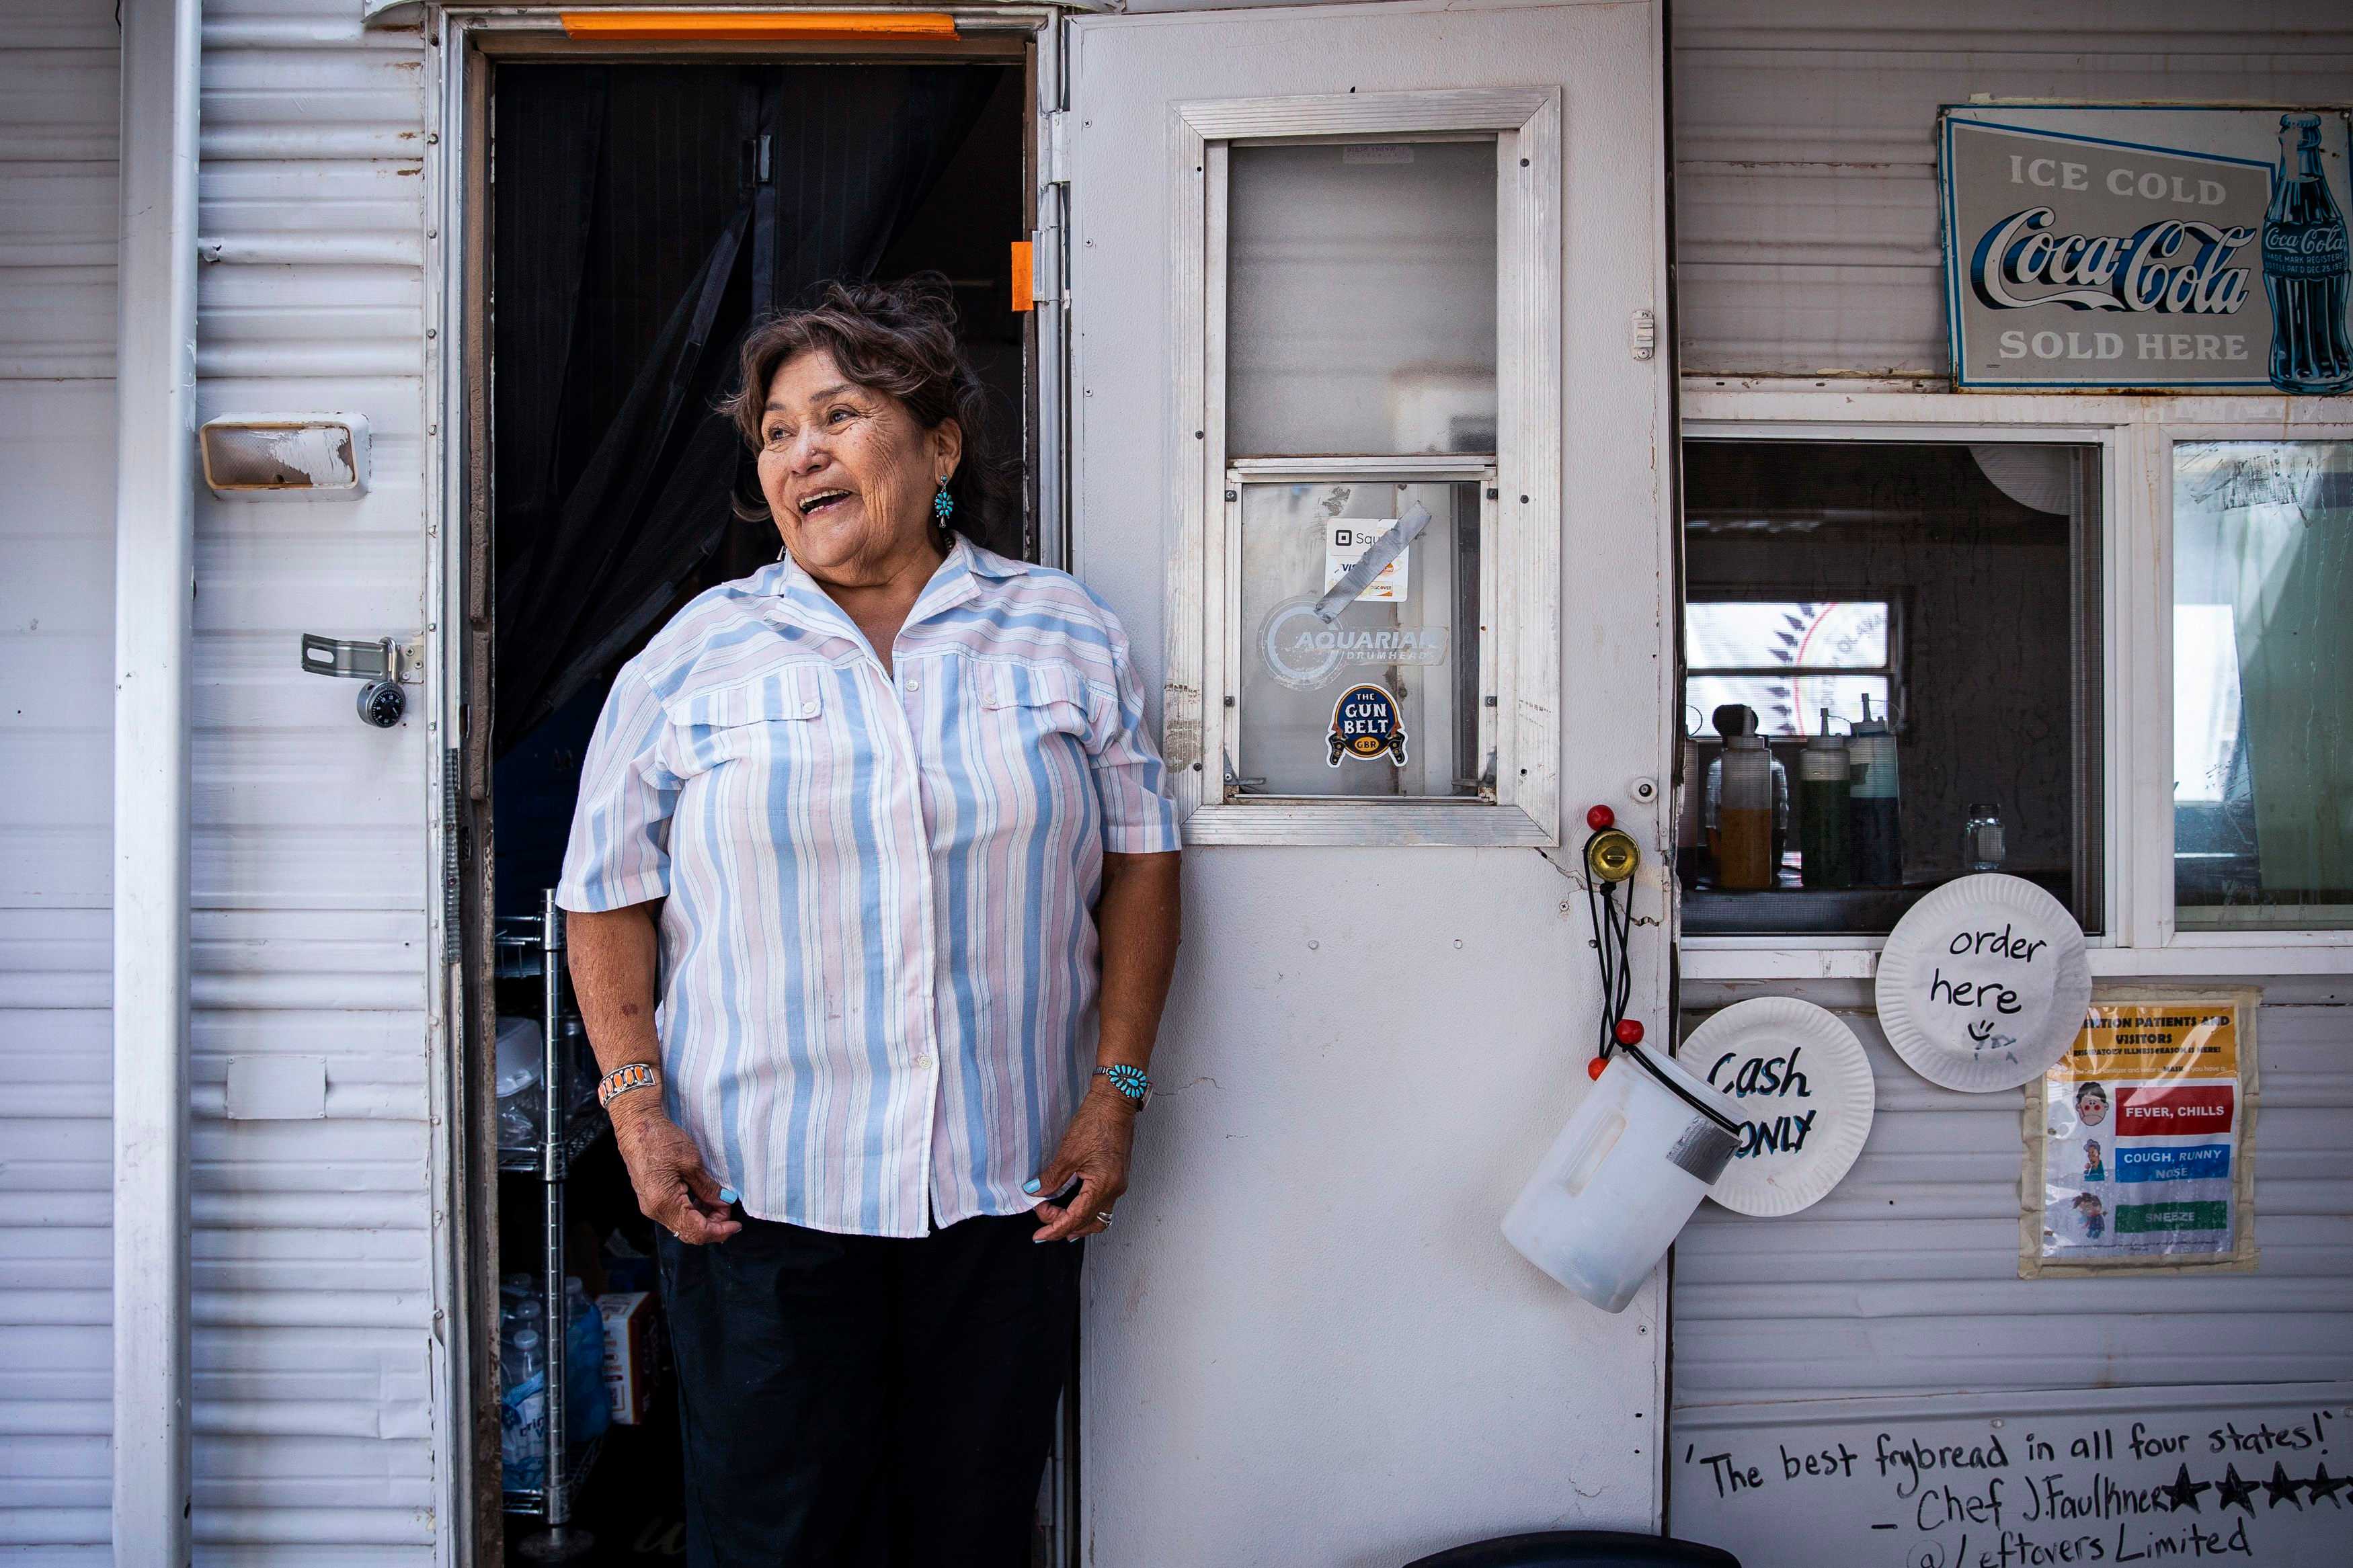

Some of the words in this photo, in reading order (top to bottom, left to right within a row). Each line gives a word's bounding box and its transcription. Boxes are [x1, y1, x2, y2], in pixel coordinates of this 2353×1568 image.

[2009, 155, 2088, 191] ICE
[2106, 168, 2227, 205] COLD
[2284, 256, 2305, 264] MARK
[1999, 331, 2124, 360] SOLD
[2137, 334, 2249, 360] HERE
[1356, 532, 1378, 546] Squ
[1345, 704, 1386, 717] GUN
[1344, 719, 1389, 734] BELT
[1356, 741, 1377, 749] GBR
[1949, 923, 2047, 962] order
[1930, 968, 2022, 1014] here
[2135, 1017, 2196, 1028] PATIENTS
[2201, 1016, 2230, 1026] AND
[2116, 1034, 2172, 1044] VISITORS
[2126, 1107, 2173, 1118] FEVER,
[2178, 1106, 2225, 1116] CHILLS
[1734, 1110, 1817, 1159] ONLY
[2124, 1152, 2175, 1164] COUGH,
[2179, 1150, 2222, 1161] RUNNY
[2156, 1167, 2188, 1179] NOSE
[2145, 1212, 2195, 1222] SNEEZE
[1780, 1443, 1858, 1480] best
[1875, 1433, 2009, 1498] frybread
[2026, 1433, 2055, 1461] in
[2070, 1429, 2113, 1460] all
[2129, 1422, 2190, 1460] four
[1917, 1478, 2006, 1531] Chef
[2116, 1516, 2254, 1563] Limited
